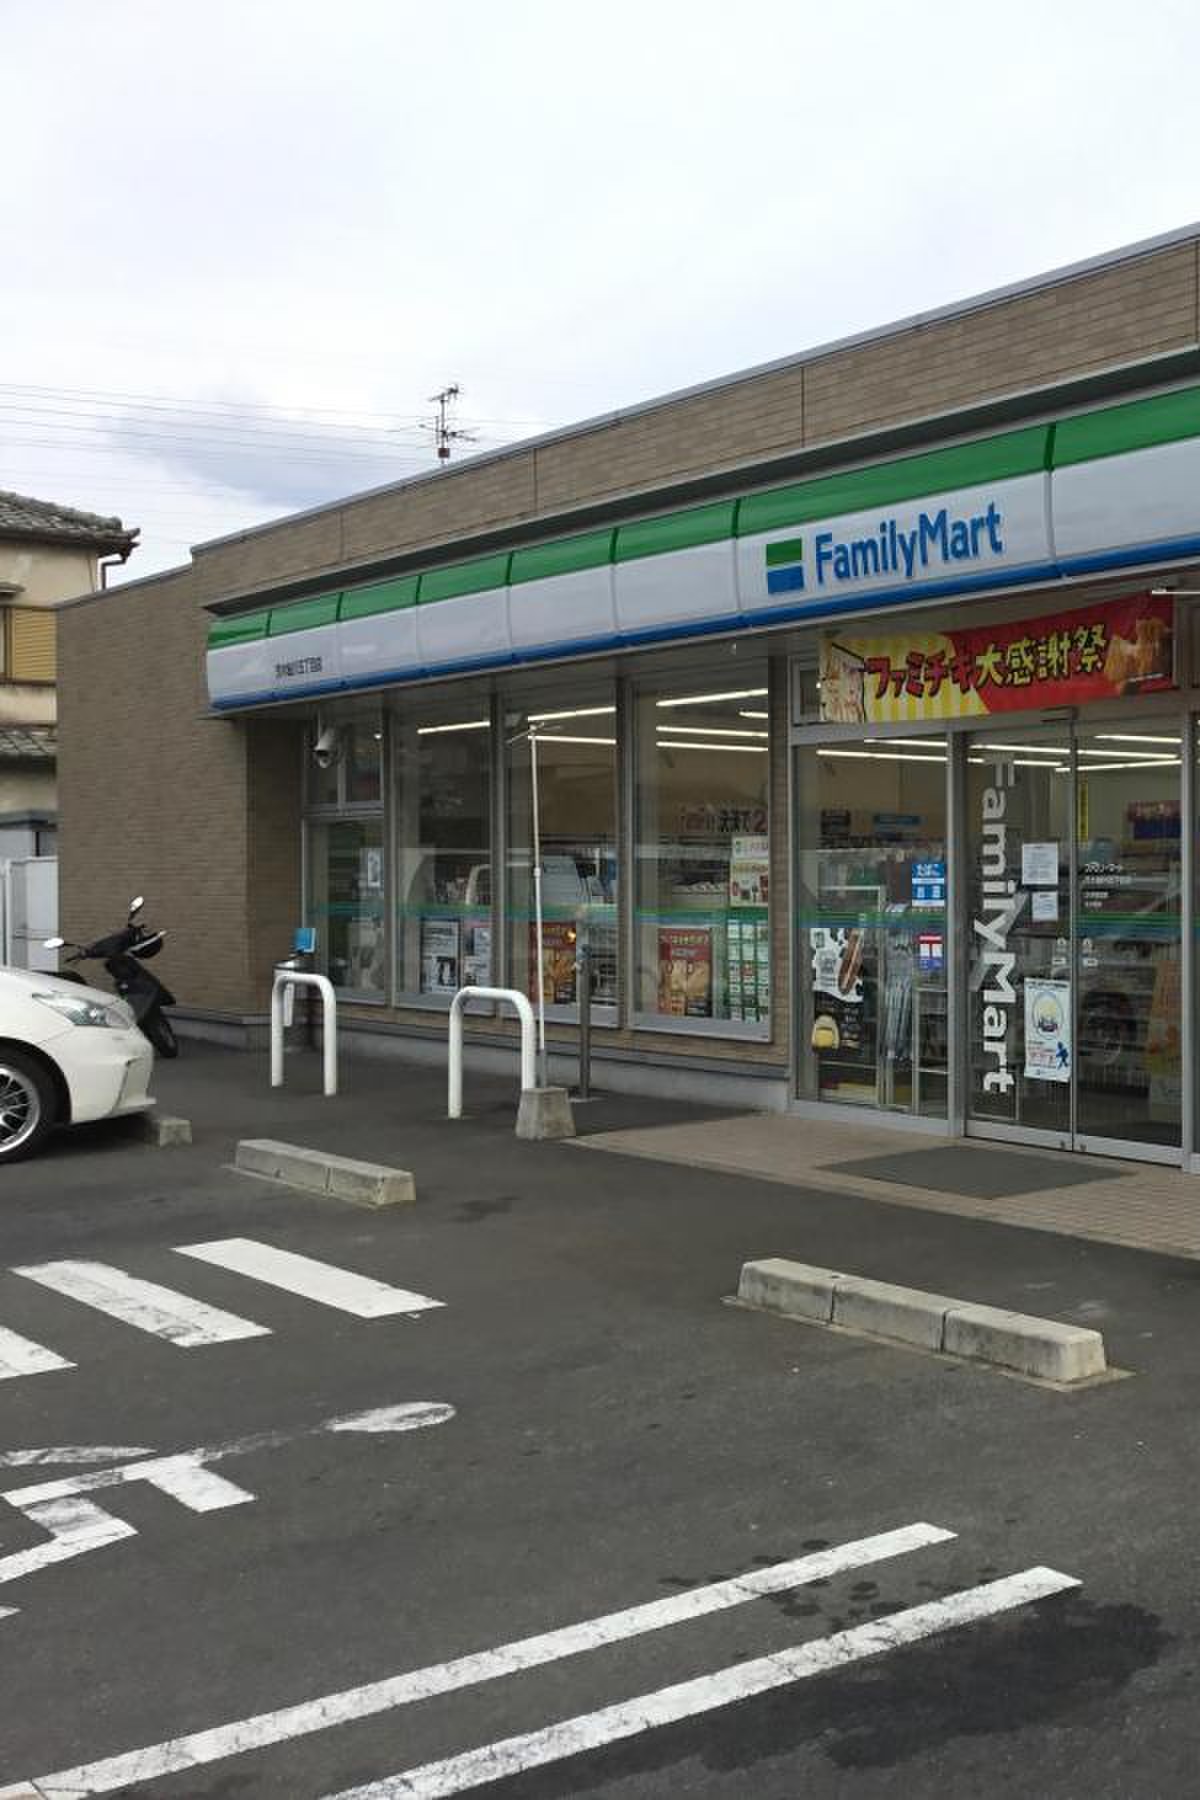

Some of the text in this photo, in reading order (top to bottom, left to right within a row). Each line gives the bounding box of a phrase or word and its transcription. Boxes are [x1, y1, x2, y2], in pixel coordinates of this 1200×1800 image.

[815, 501, 1003, 584] FamilyMart
[866, 624, 1106, 699] ファミチキ大感謝祭
[974, 753, 1016, 1093] FamilyMart
